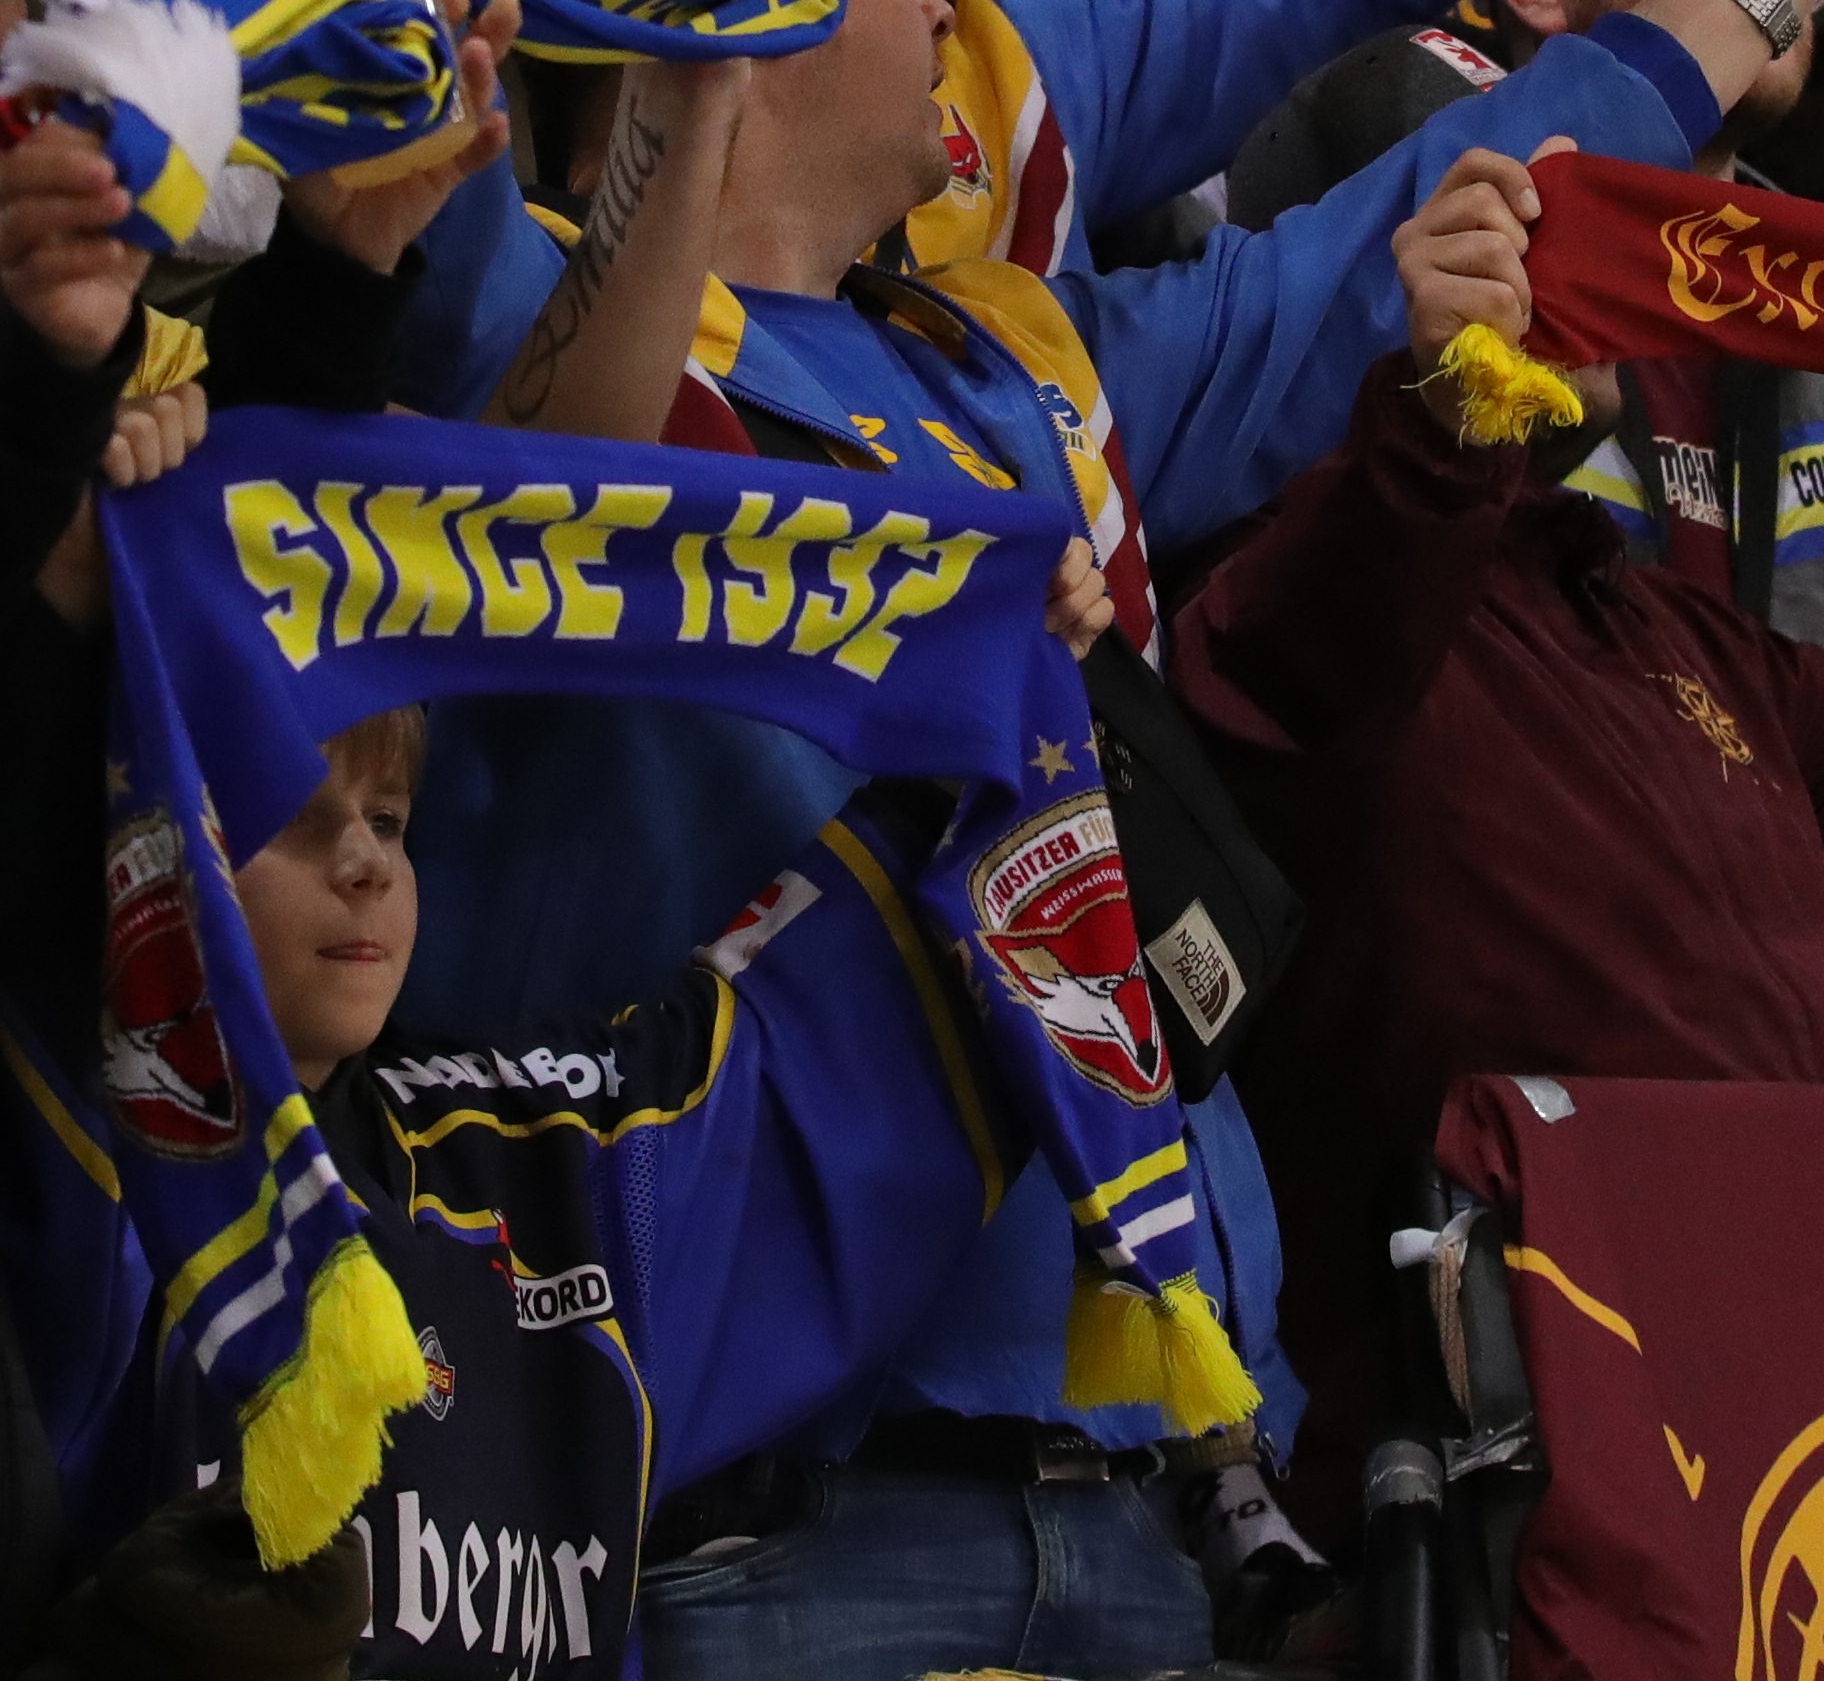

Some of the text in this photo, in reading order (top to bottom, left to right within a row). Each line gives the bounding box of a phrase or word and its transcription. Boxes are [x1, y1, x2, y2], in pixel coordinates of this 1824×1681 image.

[222, 478, 998, 683] SINCE 1932
[1171, 956, 1207, 1001] FACE
[1175, 927, 1217, 989] NORTH
[1202, 938, 1225, 976] THE
